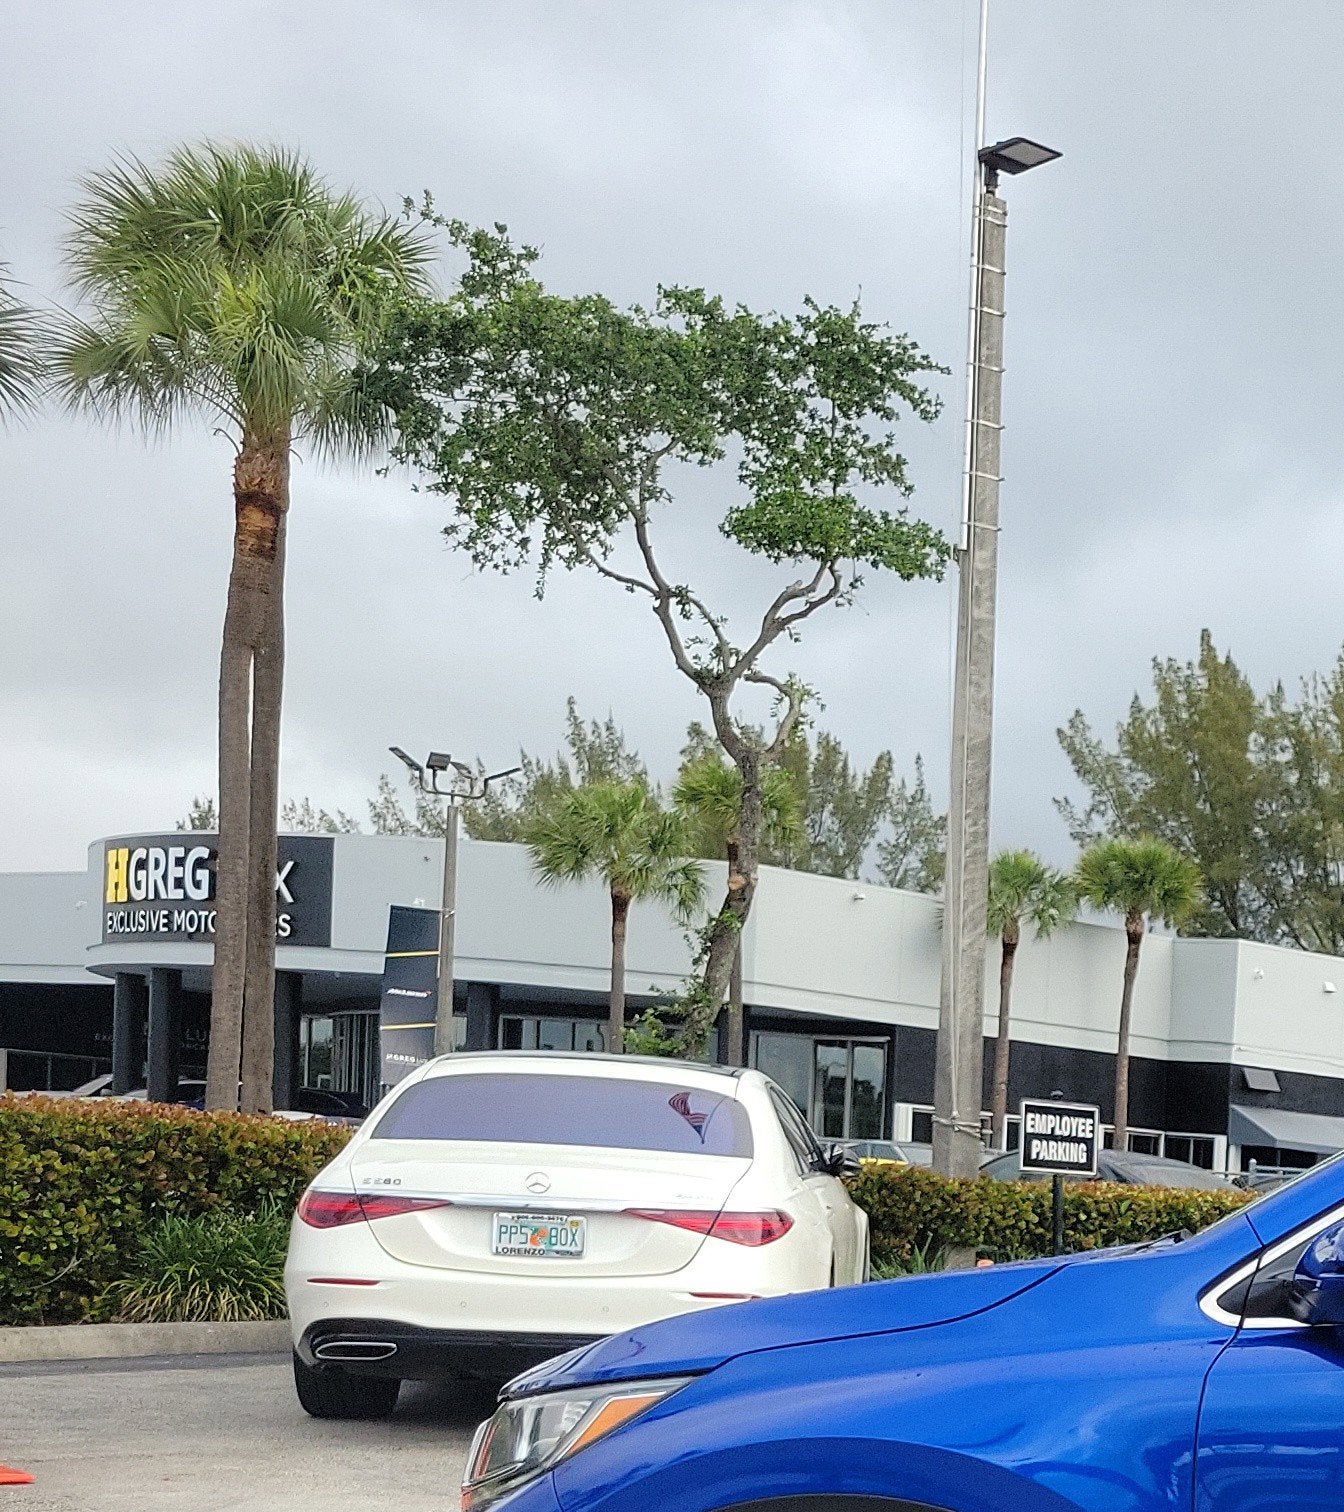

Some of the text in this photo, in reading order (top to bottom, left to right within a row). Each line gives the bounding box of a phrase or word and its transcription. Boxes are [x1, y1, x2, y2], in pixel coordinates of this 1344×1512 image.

[107, 909, 217, 934] EXCLUSIVE MOTO
[1026, 1112, 1093, 1138] EMPLOYEE
[1031, 1139, 1087, 1163] PARKING
[495, 1246, 546, 1256] LORENZO
